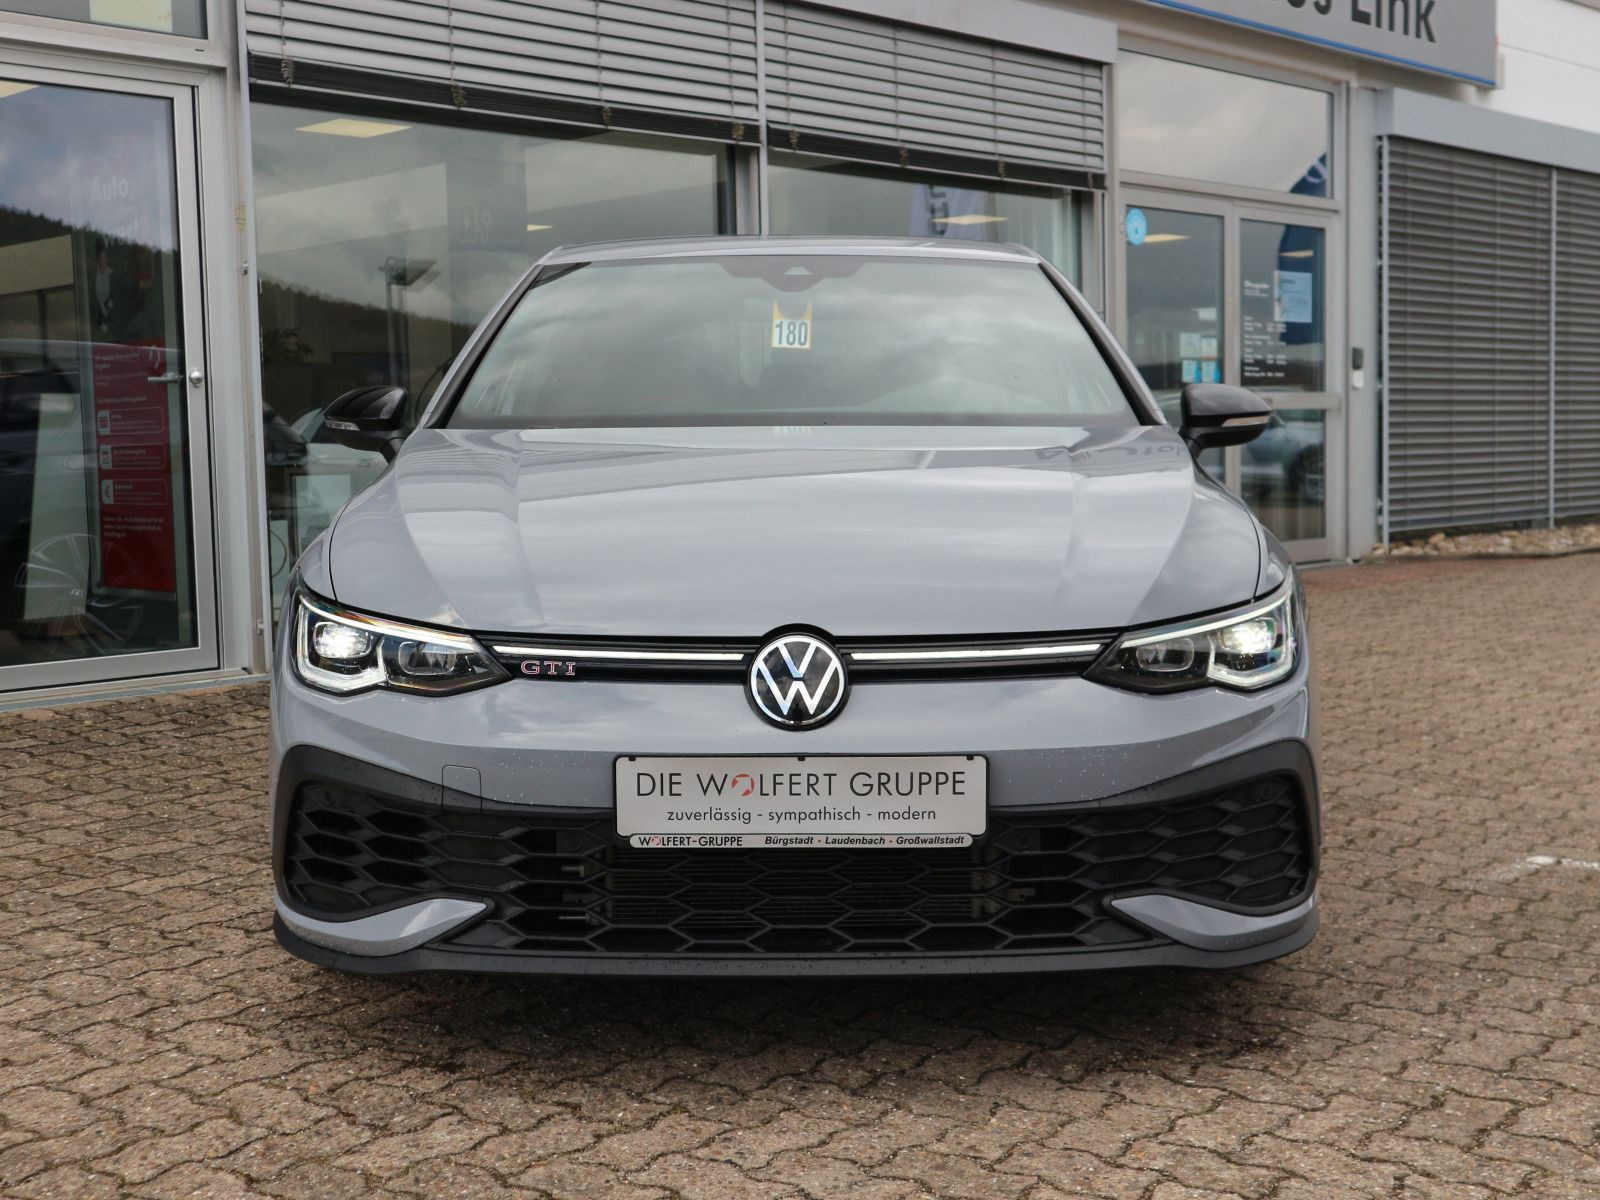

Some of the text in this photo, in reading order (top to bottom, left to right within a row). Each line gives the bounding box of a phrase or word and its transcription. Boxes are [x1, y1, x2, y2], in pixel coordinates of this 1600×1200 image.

[775, 320, 809, 346] 180
[520, 660, 576, 676] GTI
[636, 771, 966, 797] DIE WOLFERT GRUPPE
[667, 806, 751, 824] zuverlässig
[768, 805, 861, 824] sympathisch
[878, 805, 936, 821] modern
[764, 836, 814, 846] Bürgstadt
[825, 836, 886, 845] Laudenbach
[896, 835, 965, 845] Großwallstadt
